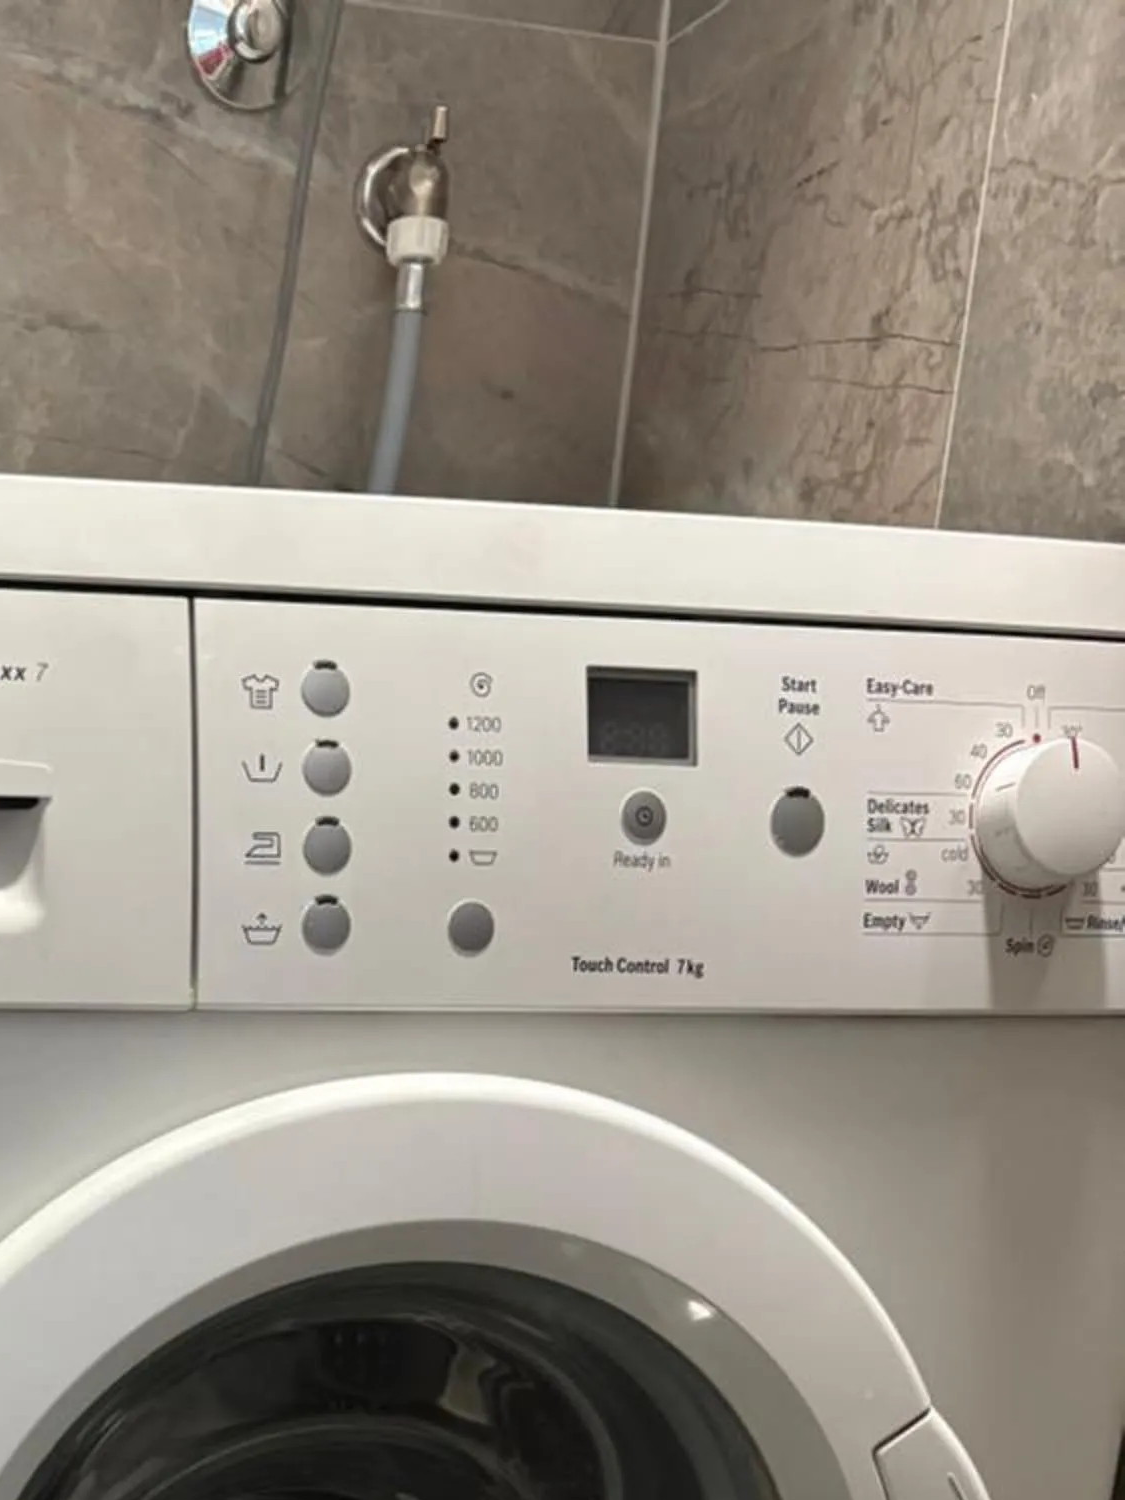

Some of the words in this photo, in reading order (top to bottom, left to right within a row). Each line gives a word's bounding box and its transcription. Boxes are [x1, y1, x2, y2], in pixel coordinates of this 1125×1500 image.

[36, 661, 49, 682] 7
[781, 676, 817, 693] Start
[866, 677, 934, 698] Easy-Care
[778, 699, 820, 715] Pause
[467, 716, 502, 733] 1200
[467, 750, 504, 767] 1000
[469, 783, 499, 800] 800
[867, 798, 930, 815] Delicates
[469, 816, 499, 833] 600
[867, 817, 892, 833] Silk
[613, 851, 655, 872] Ready
[658, 852, 671, 868] in
[941, 845, 969, 862] cold
[865, 879, 900, 895] Wool
[863, 912, 907, 932] Empty
[1005, 938, 1035, 956] Spin
[571, 956, 614, 973] Touch
[616, 957, 670, 974] Control
